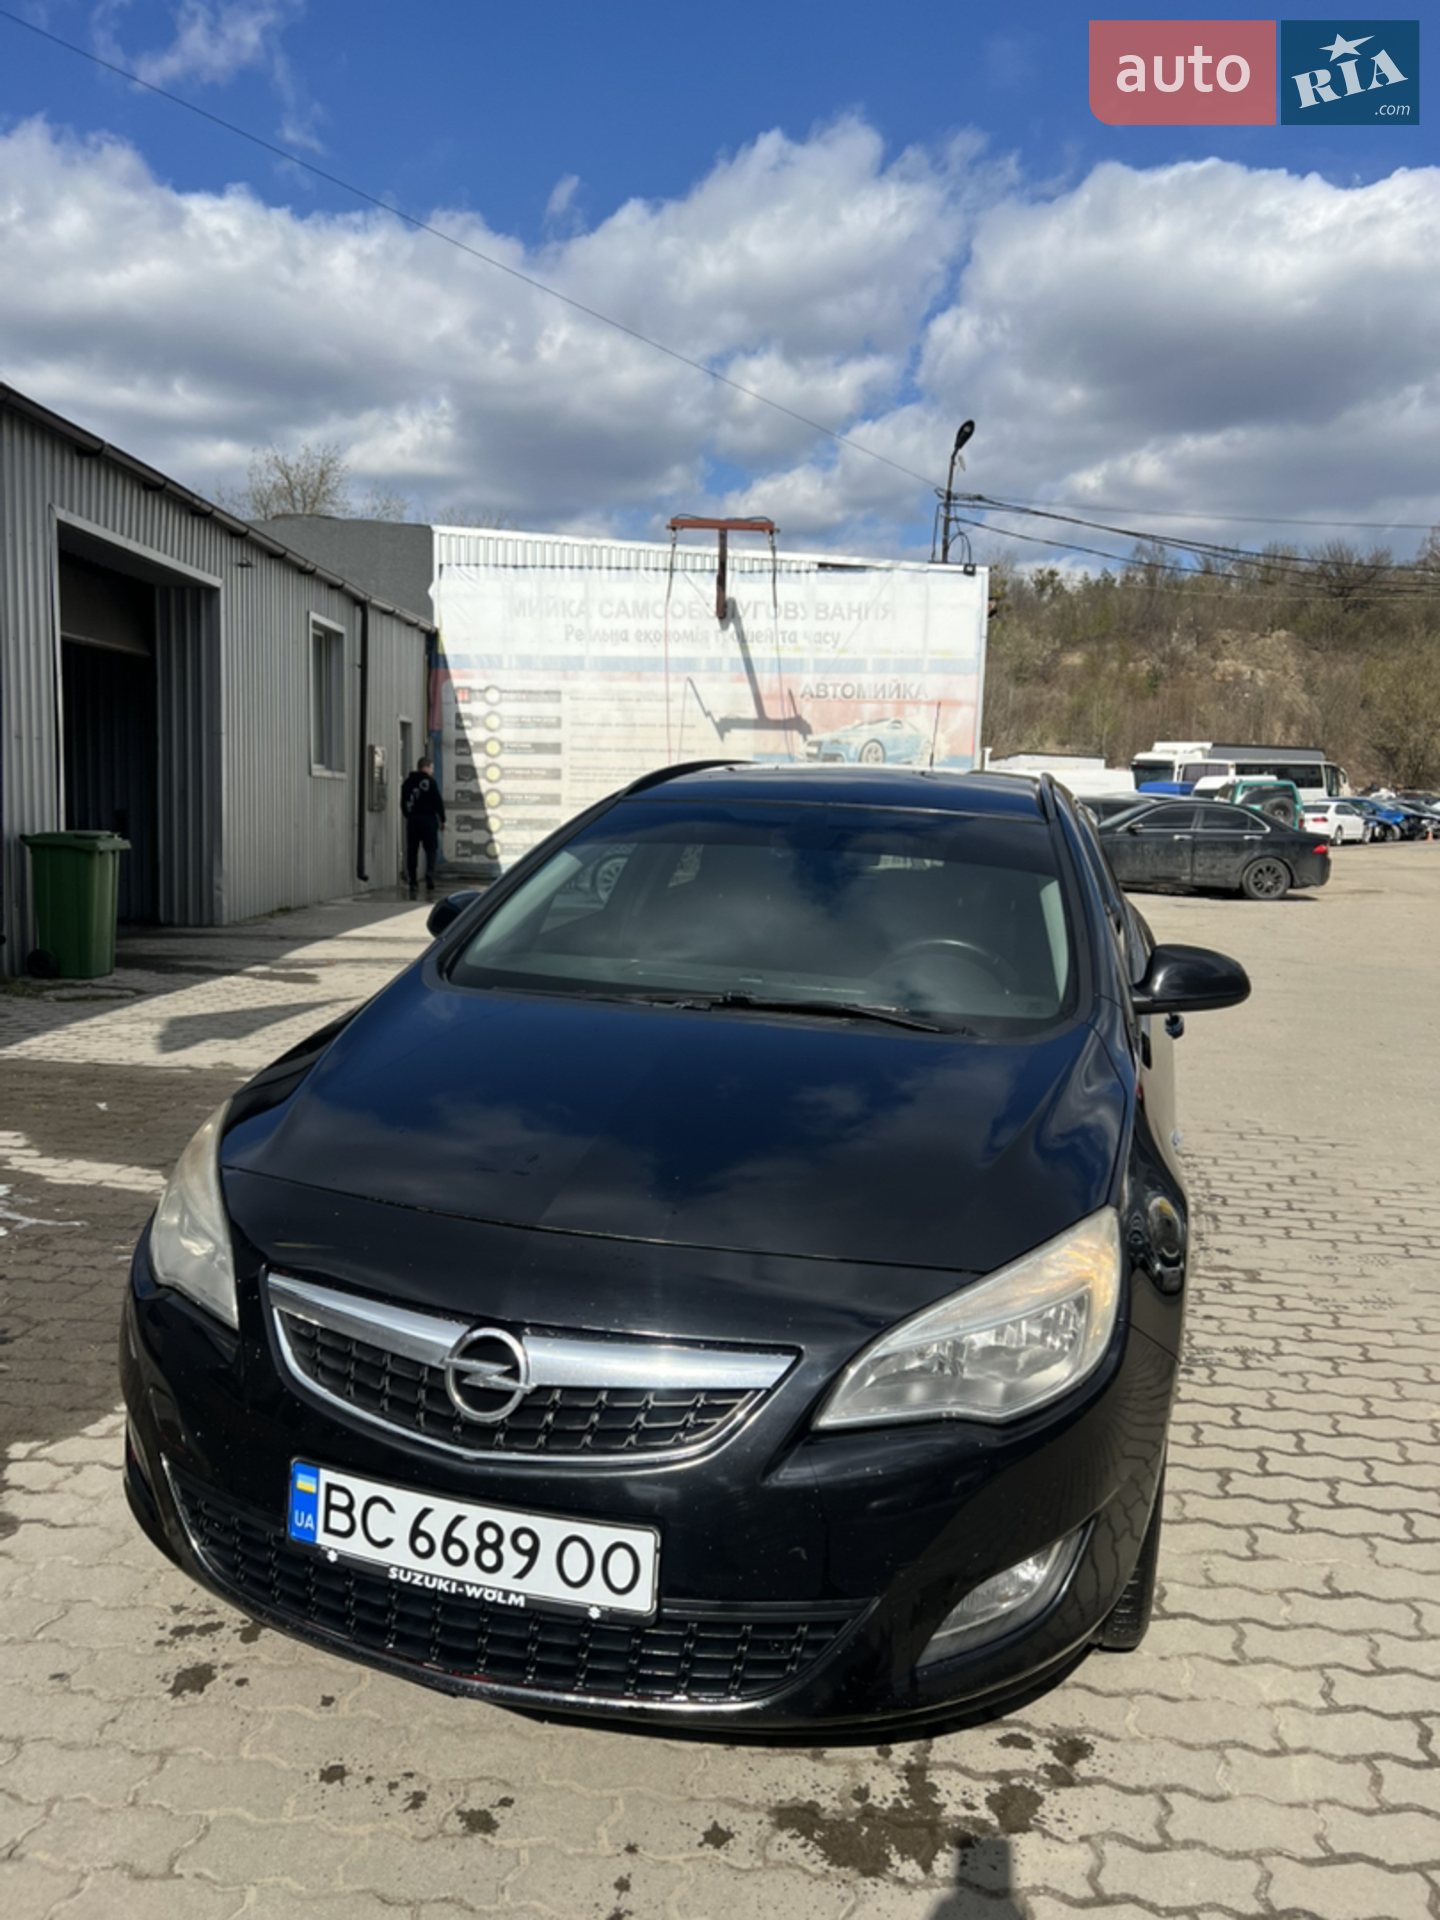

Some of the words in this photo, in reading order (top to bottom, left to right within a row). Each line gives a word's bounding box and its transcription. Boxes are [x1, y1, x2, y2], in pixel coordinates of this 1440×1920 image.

[511, 593, 590, 618] МИЙКА
[780, 630, 798, 645] та
[800, 678, 929, 700] АВТОМИЙКА
[294, 1509, 315, 1530] UA
[323, 1482, 396, 1549] BC
[408, 1507, 541, 1580] 6689
